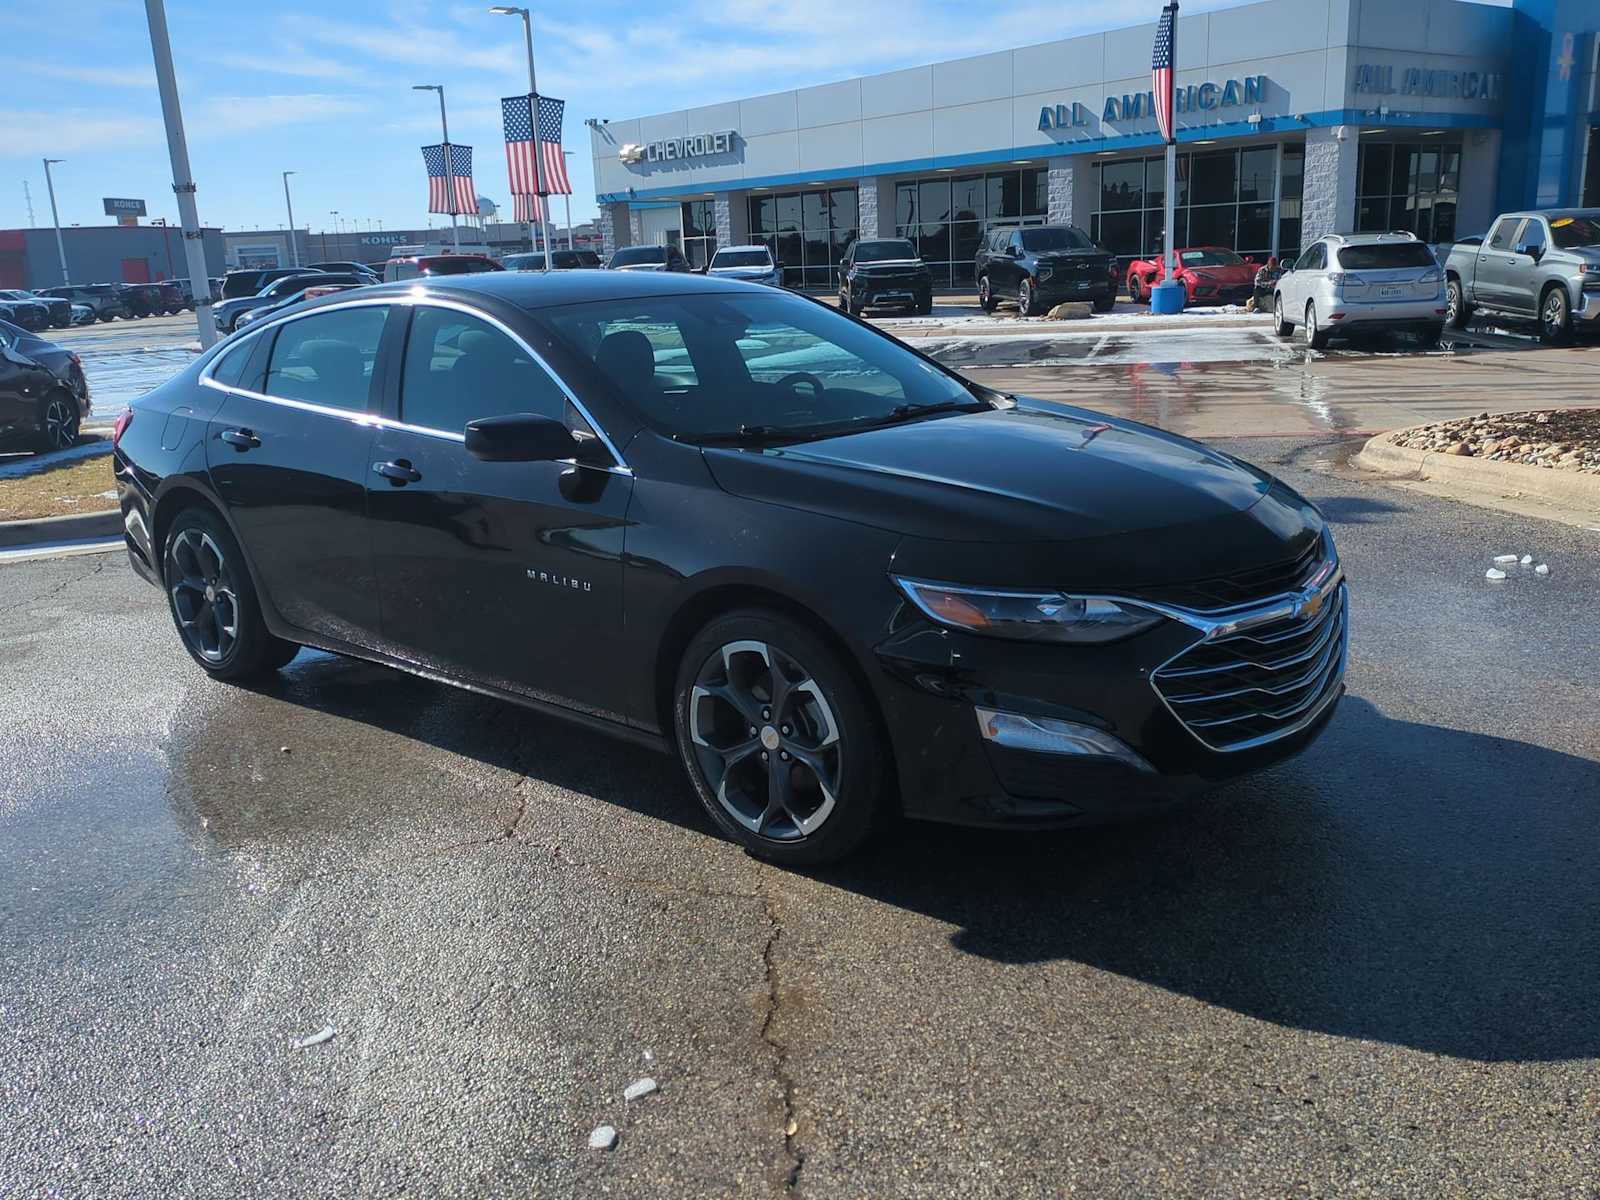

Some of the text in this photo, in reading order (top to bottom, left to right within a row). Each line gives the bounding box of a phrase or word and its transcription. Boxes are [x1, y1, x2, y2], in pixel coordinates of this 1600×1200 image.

[1038, 103, 1087, 130] ALL
[646, 130, 734, 162] CHEVROLET
[361, 235, 408, 245] KOHL'S
[526, 569, 592, 592] MALIBU
